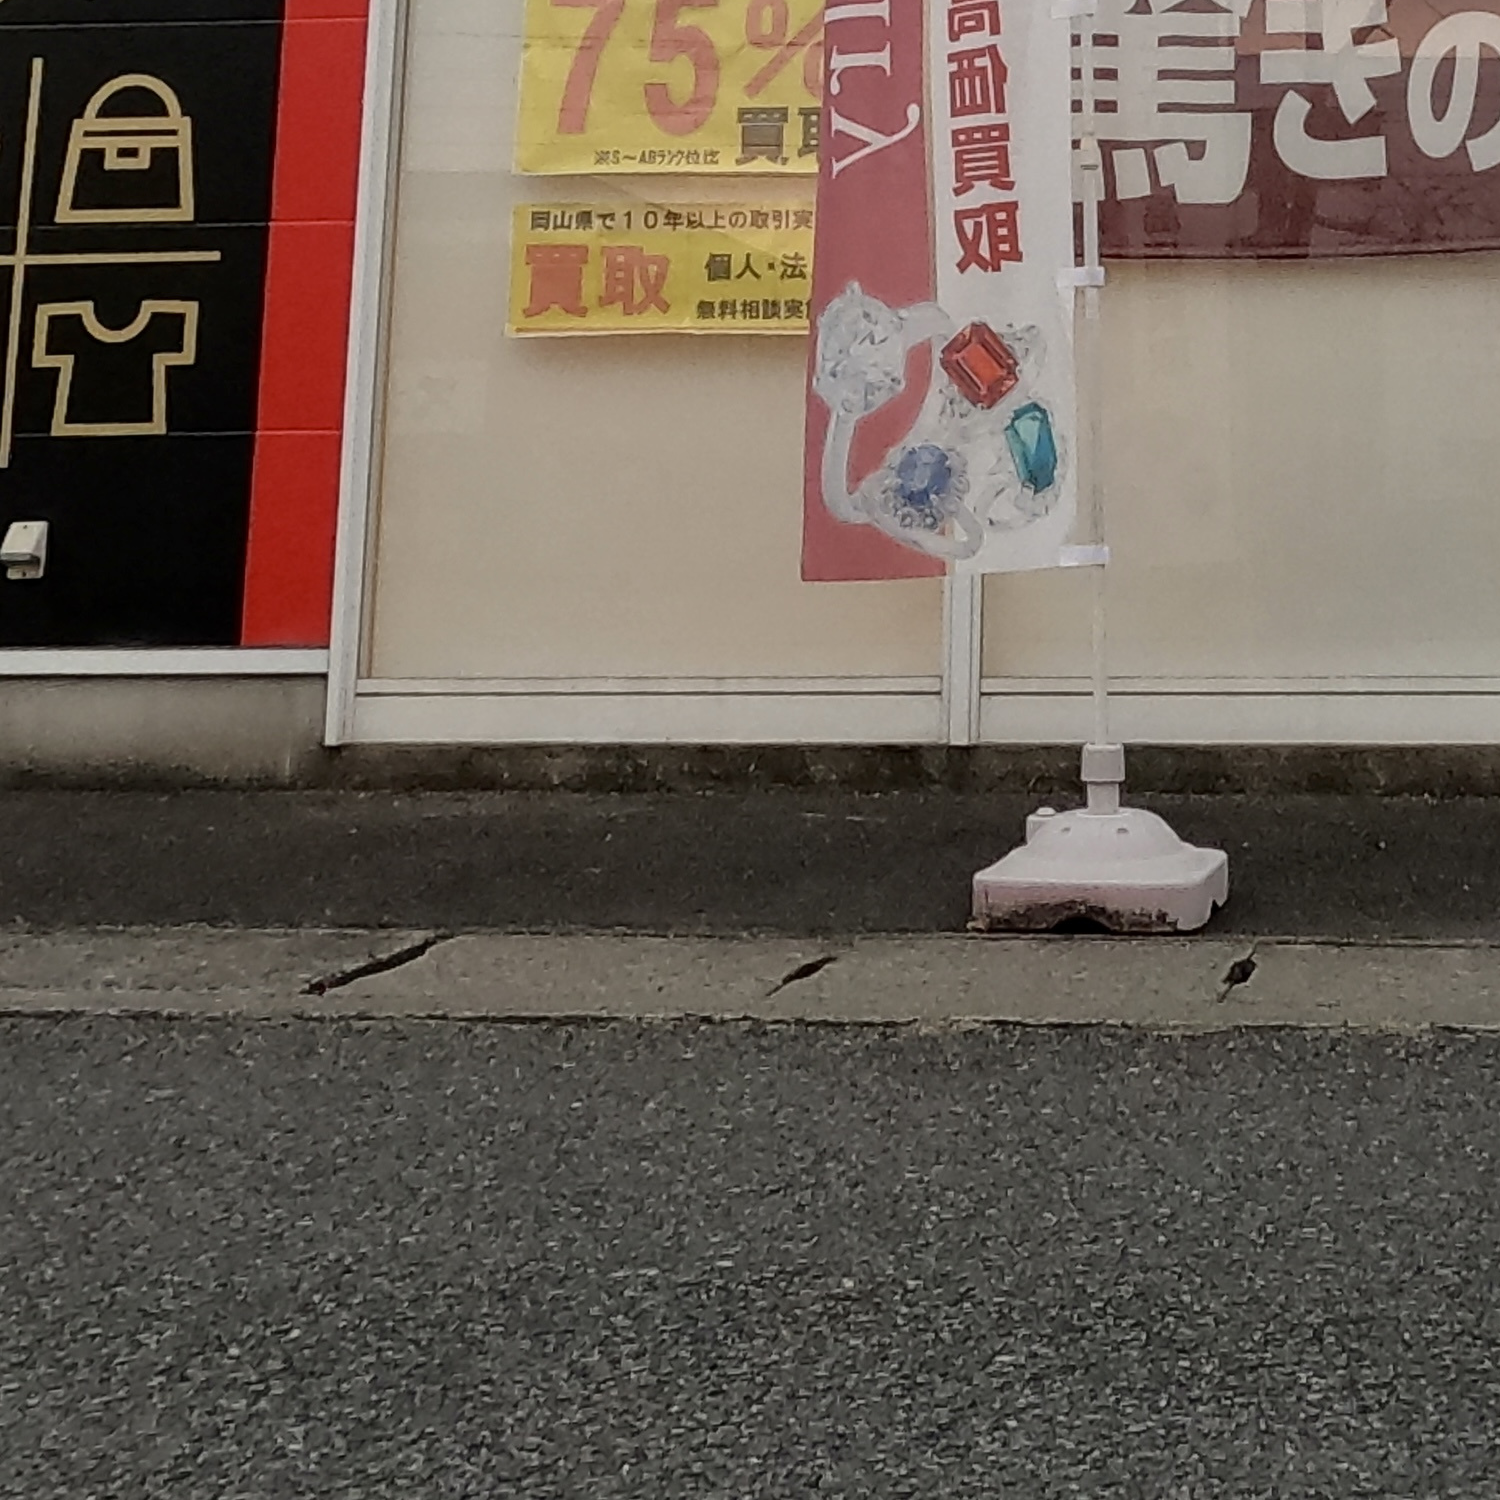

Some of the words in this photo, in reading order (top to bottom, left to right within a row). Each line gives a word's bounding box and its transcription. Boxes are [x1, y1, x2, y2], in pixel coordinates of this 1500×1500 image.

[523, 243, 671, 318] 買取
[696, 298, 813, 321] 無料相談実
